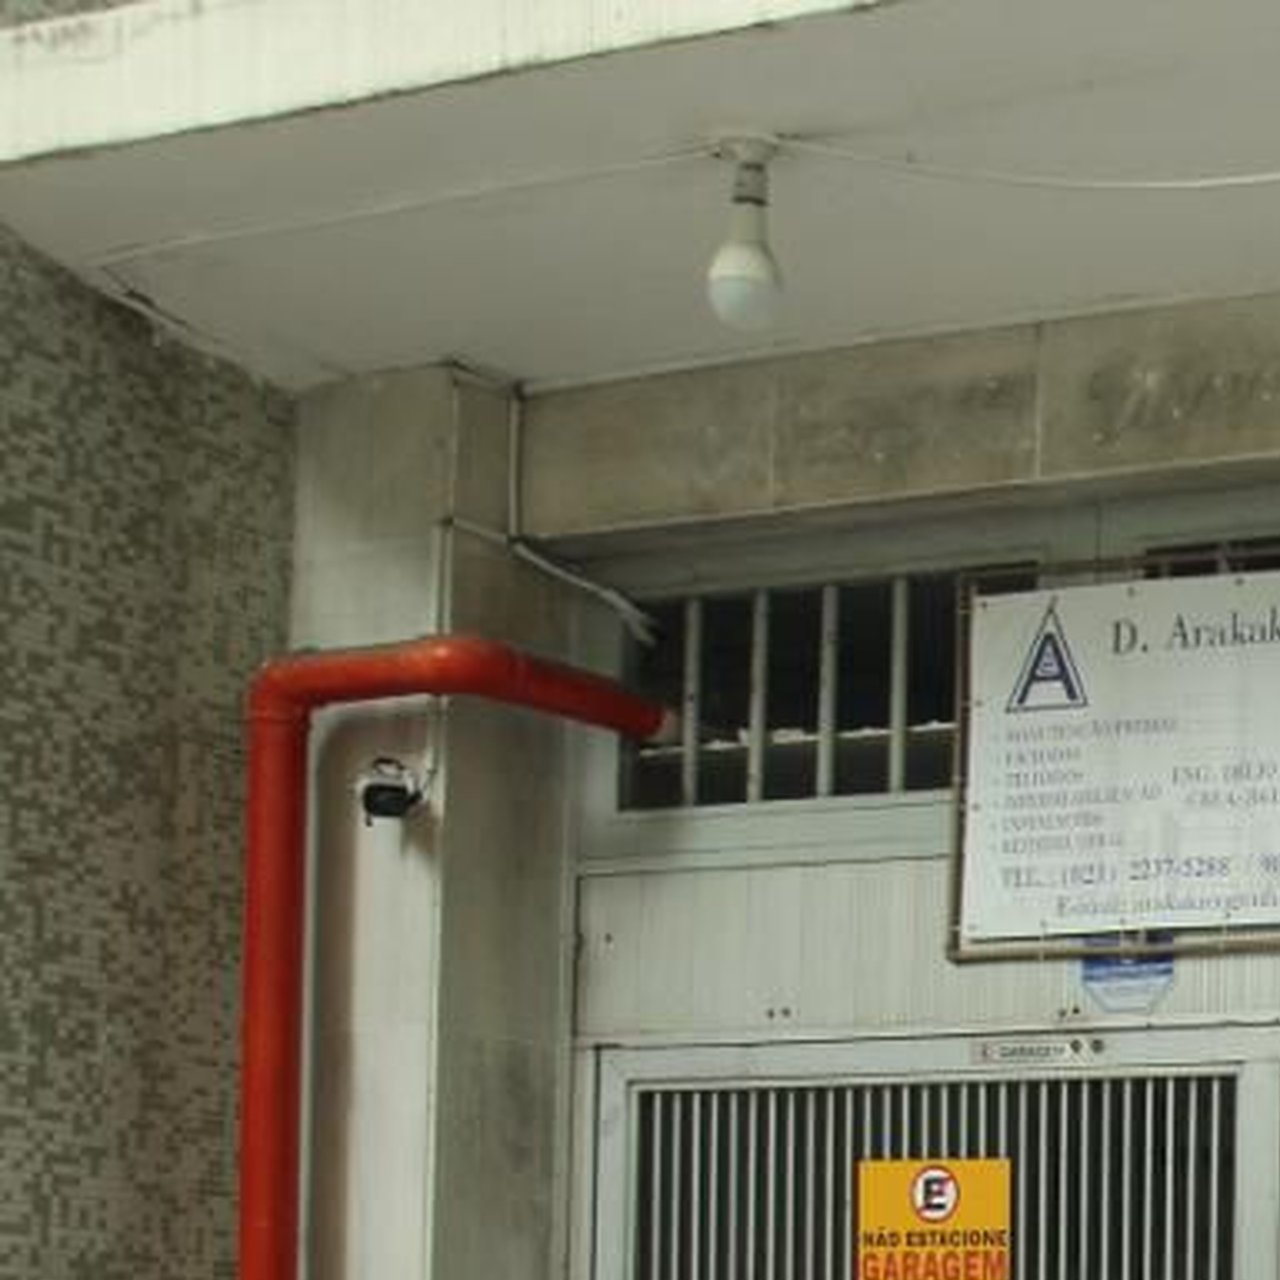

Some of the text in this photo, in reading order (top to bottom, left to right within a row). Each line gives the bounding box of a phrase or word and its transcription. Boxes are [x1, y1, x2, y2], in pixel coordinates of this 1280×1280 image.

[1111, 619, 1149, 656] D.
[862, 1226, 1008, 1248] NÃO ESTACIONE
